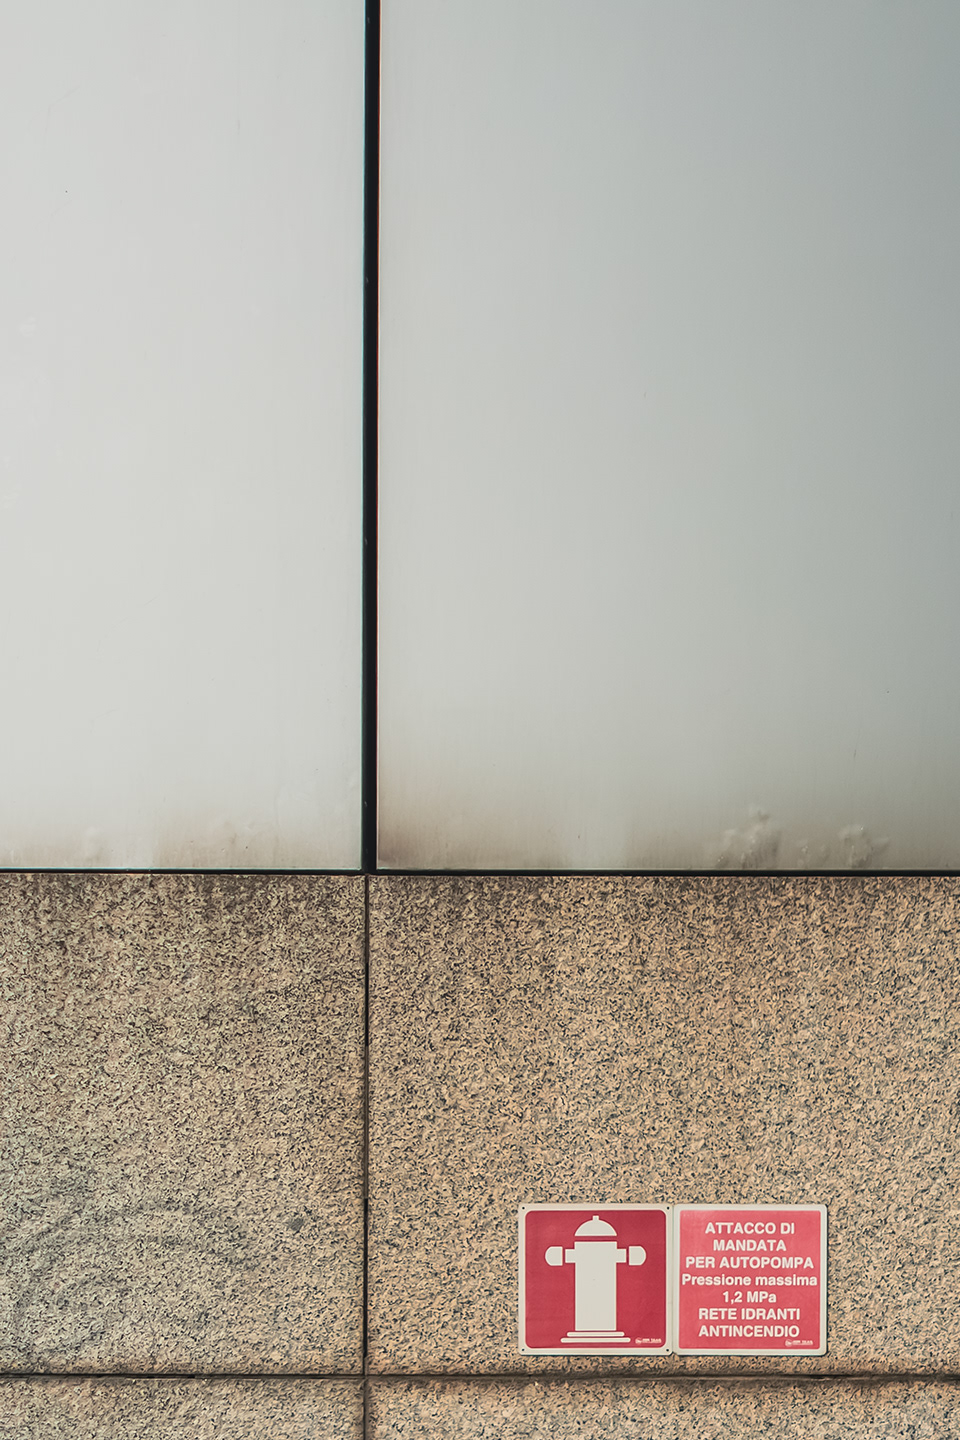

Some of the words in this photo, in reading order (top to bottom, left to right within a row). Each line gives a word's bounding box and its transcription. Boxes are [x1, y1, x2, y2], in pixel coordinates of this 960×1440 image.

[704, 1221, 777, 1235] ATTACCO
[780, 1222, 795, 1235] DI
[713, 1239, 787, 1252] MANDATA
[685, 1256, 716, 1269] PER
[719, 1256, 815, 1269] AUTOPOMPA
[681, 1273, 752, 1286] Pressione
[755, 1273, 818, 1286] massima
[722, 1290, 743, 1305] 1,2
[746, 1290, 777, 1304] MPa
[698, 1307, 738, 1320] RETE
[741, 1307, 801, 1321] IDRANTI
[698, 1324, 800, 1338] ANTINCENDIO
